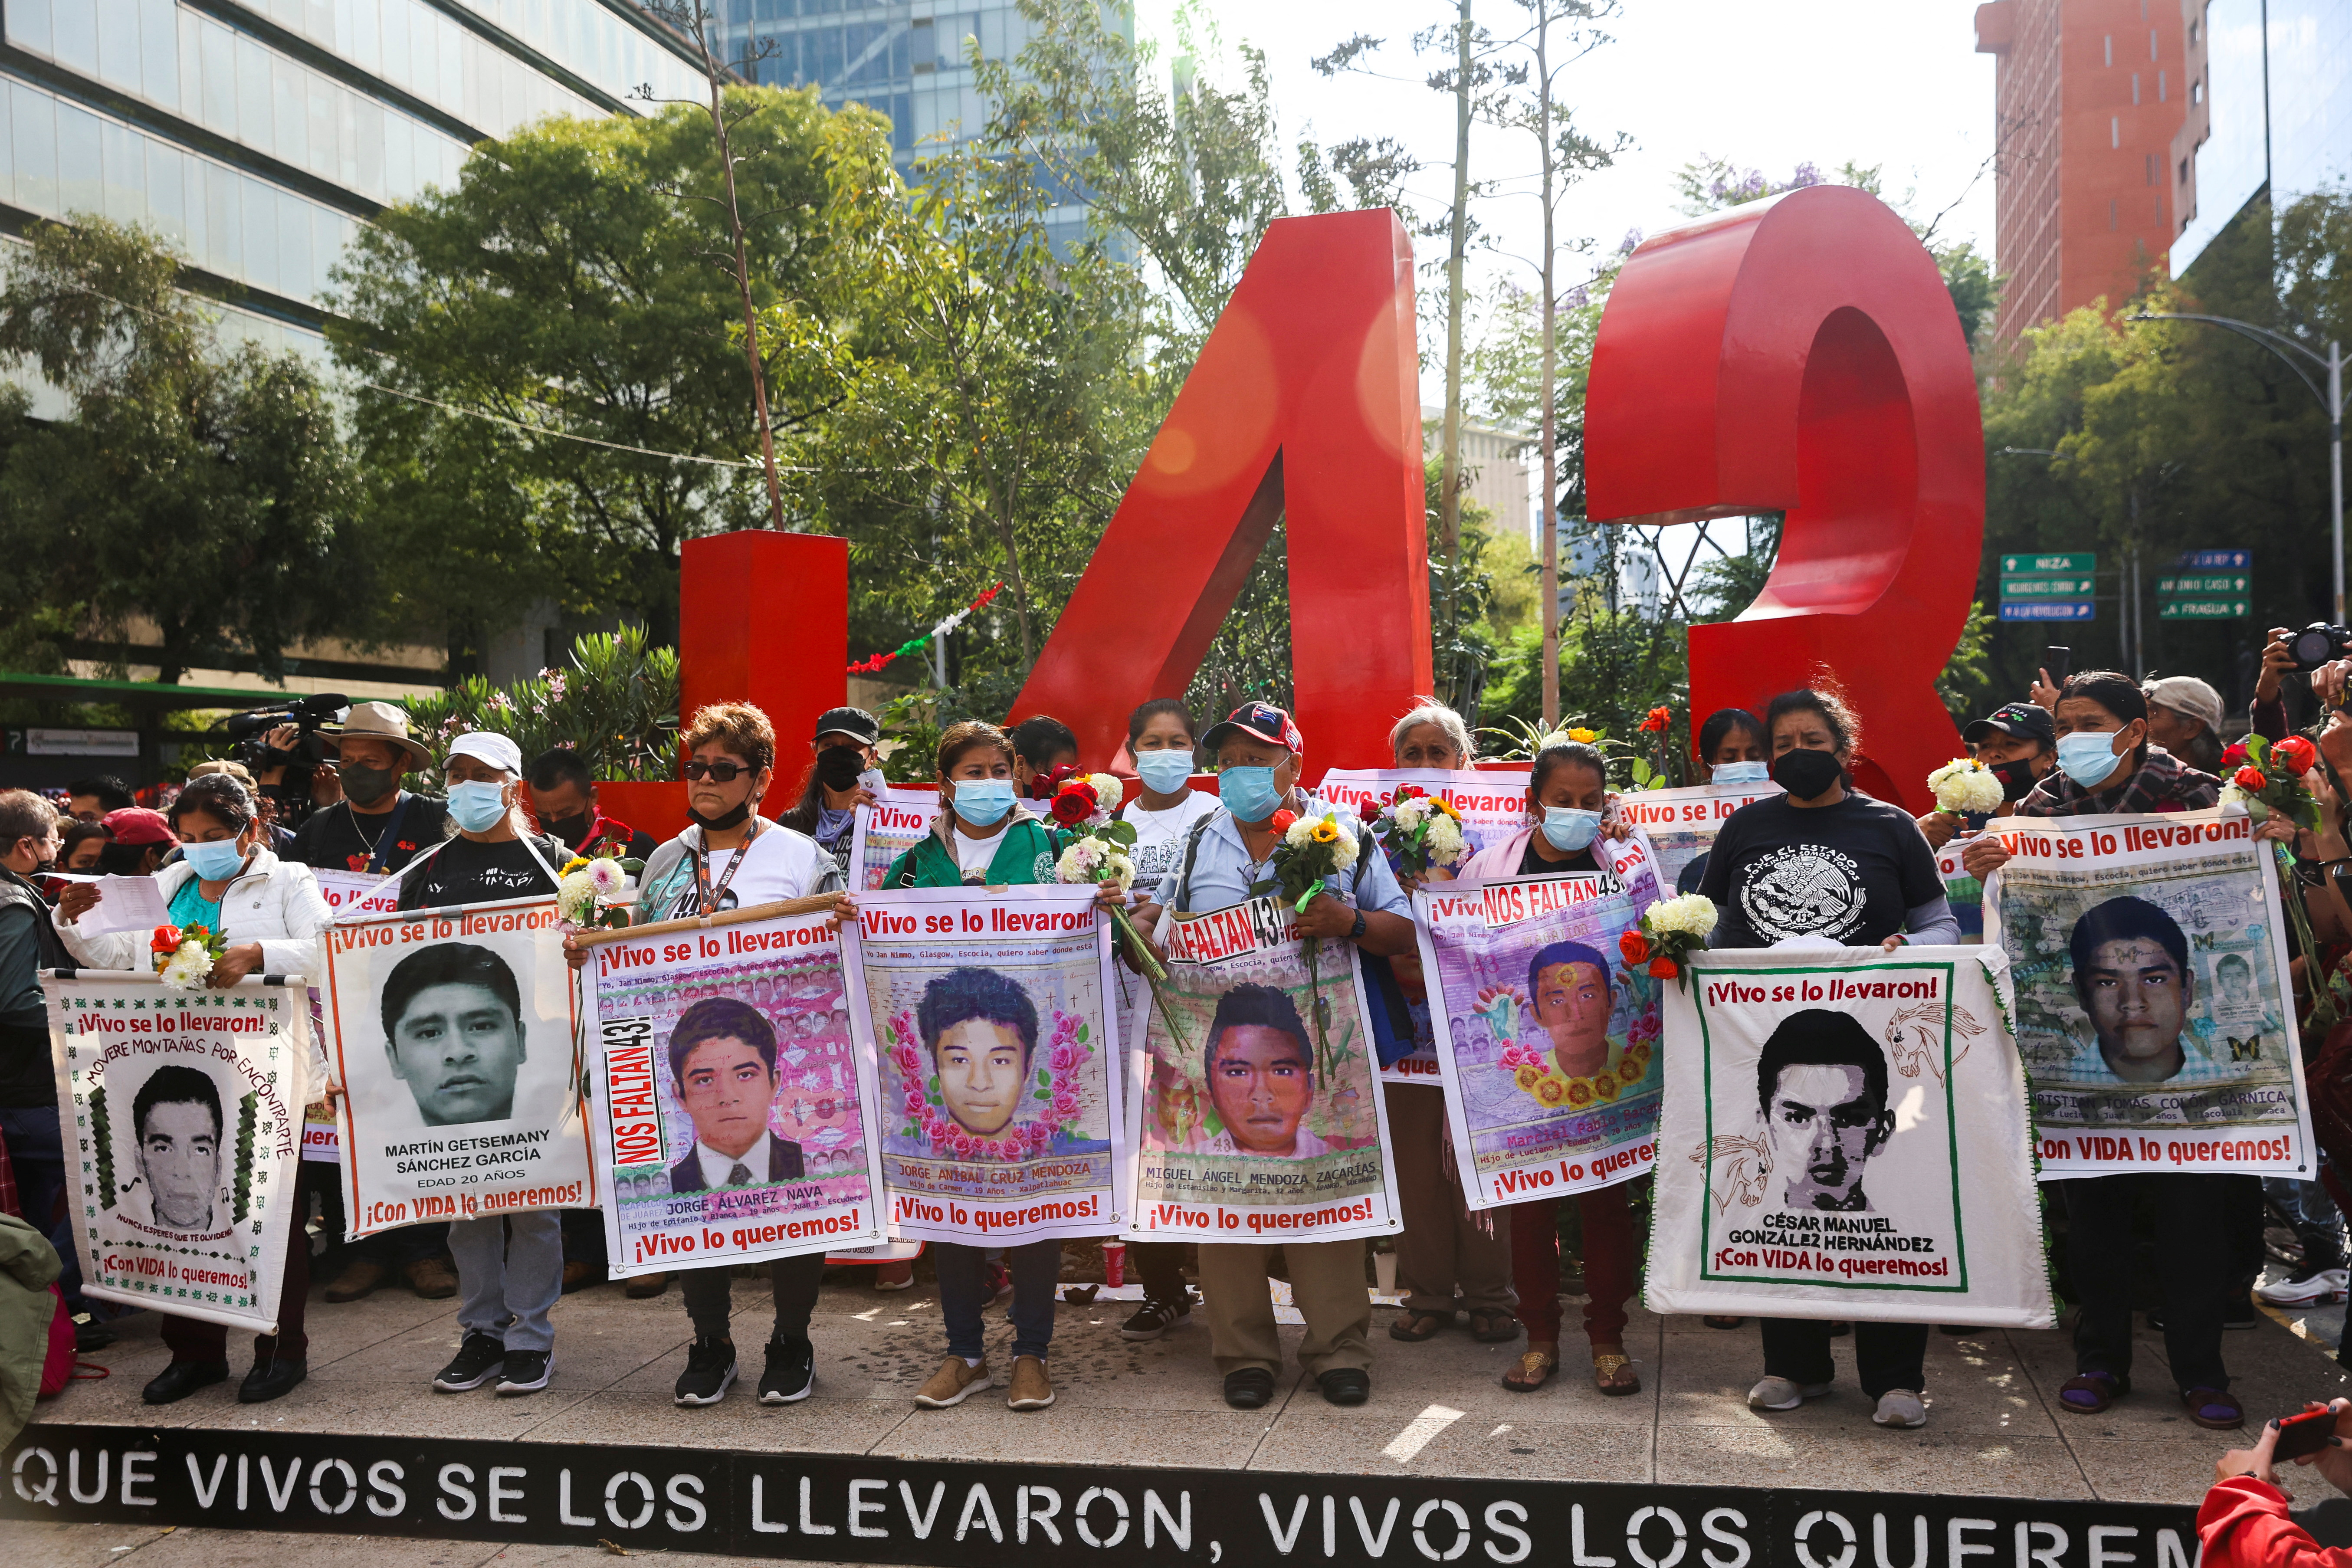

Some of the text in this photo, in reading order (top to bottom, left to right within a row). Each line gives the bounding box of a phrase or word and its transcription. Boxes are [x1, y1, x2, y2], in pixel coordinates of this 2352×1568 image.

[2036, 558, 2071, 569] NIZA
[2161, 578, 2231, 590] ANONIO CASO
[2182, 603, 2230, 615] FRAGUA
[9, 731, 21, 750] 7
[871, 807, 922, 830] ¡Vivo
[1620, 803, 1675, 824] ¡Vivo
[1683, 804, 1707, 821] se
[1714, 800, 1735, 819] lo
[397, 840, 417, 851] 43
[2001, 818, 2250, 859] Vivo se lo llevaron!
[1744, 844, 1858, 872] FUE EL ESTADO
[1746, 851, 1860, 886] AYOTZINAPA SOMOS TODOS
[1483, 879, 1598, 925] NOS FALTAN
[335, 907, 559, 954] ¡Vivo se lo llevaron!
[860, 905, 1094, 939] ¡Vivo se lo llevaron!
[1181, 907, 1256, 962] FALTAN
[1252, 898, 1284, 949] 43!
[601, 919, 834, 977] ¡Vivo se lo llevaron!
[919, 951, 954, 959] Glasgow,
[958, 949, 992, 958] Escocia,
[997, 949, 1023, 958] quiero
[1052, 945, 1073, 955] dónde
[1076, 942, 1092, 951] está
[1473, 955, 1499, 975] 43
[1708, 977, 1937, 1007] ¡Vivo se lo llevaron!
[79, 1012, 264, 1036] ¡Vivo se lo llevaron!
[87, 1041, 130, 1086] MOVERE
[132, 1036, 206, 1054] MONTAÑAS
[211, 1041, 238, 1064] POR
[237, 1057, 294, 1160] ENCONTRARTE
[602, 1016, 659, 1165] NOS FALTAN 43!
[2107, 1095, 2151, 1110] TOMÁS
[2160, 1094, 2209, 1110] COLÓN
[2218, 1090, 2286, 1106] GARNICA
[1578, 1115, 1617, 1134] Pablo
[385, 1129, 550, 1158] MARTÍN GETSEMANY
[1214, 1138, 1231, 1152] 43
[2033, 1135, 2291, 1165] Con VIDA lo queremos!
[397, 1147, 541, 1173] SÁNCHEZ GARCÍA
[899, 1162, 1091, 1184] JORGE ANÍBAL CRUZ MENDOZA
[1146, 1161, 1376, 1185] MIGUEL ÁNGEL MENDOZA ZACARÍAS
[418, 1169, 525, 1188] EDAD 20 AÑOS
[1145, 1181, 1164, 1191] Hijo
[1178, 1183, 1218, 1192] Estanislao
[1229, 1186, 1270, 1195] Margarita,
[1346, 1174, 1378, 1187] GUERRERO
[1493, 1161, 1584, 1201] ¡Vivo lo
[366, 1180, 582, 1227] ¡Con VIDA lo queremos!
[628, 1221, 646, 1231] Hijo
[663, 1215, 699, 1227] Epifanio
[710, 1211, 737, 1220] Blanca
[762, 1205, 780, 1214] años
[793, 1201, 811, 1210] Juan
[814, 1199, 824, 1207] R.
[827, 1194, 863, 1206] Escudero
[667, 1185, 823, 1215] JORGE ÁLVAREZ NAVA
[895, 1194, 1098, 1232] ¡Vivo lo queremos!
[116, 1213, 143, 1231] NUNCA
[143, 1226, 173, 1239] ESPERES
[1150, 1197, 1373, 1234] ¡Vivo lo queremos!
[1763, 1212, 1897, 1233] CÉSAR MANUEL
[635, 1208, 859, 1263] ¡Vivo lo queremos!
[1728, 1229, 1935, 1252] GONZÁLEZ HERNÁNDEZ
[103, 1254, 248, 1289] ¡Con VIDA lo queremos!
[1715, 1247, 1949, 1278] ¡Con VIDA lo queremos!
[12, 1447, 158, 1507] QUE
[186, 1453, 407, 1518] VIVOS
[436, 1463, 528, 1523] SE
[560, 1467, 708, 1533] LOS
[751, 1473, 1224, 1566] LLEVARON,
[1258, 1493, 1532, 1564] VIVOS
[1571, 1503, 1752, 1568] LOS
